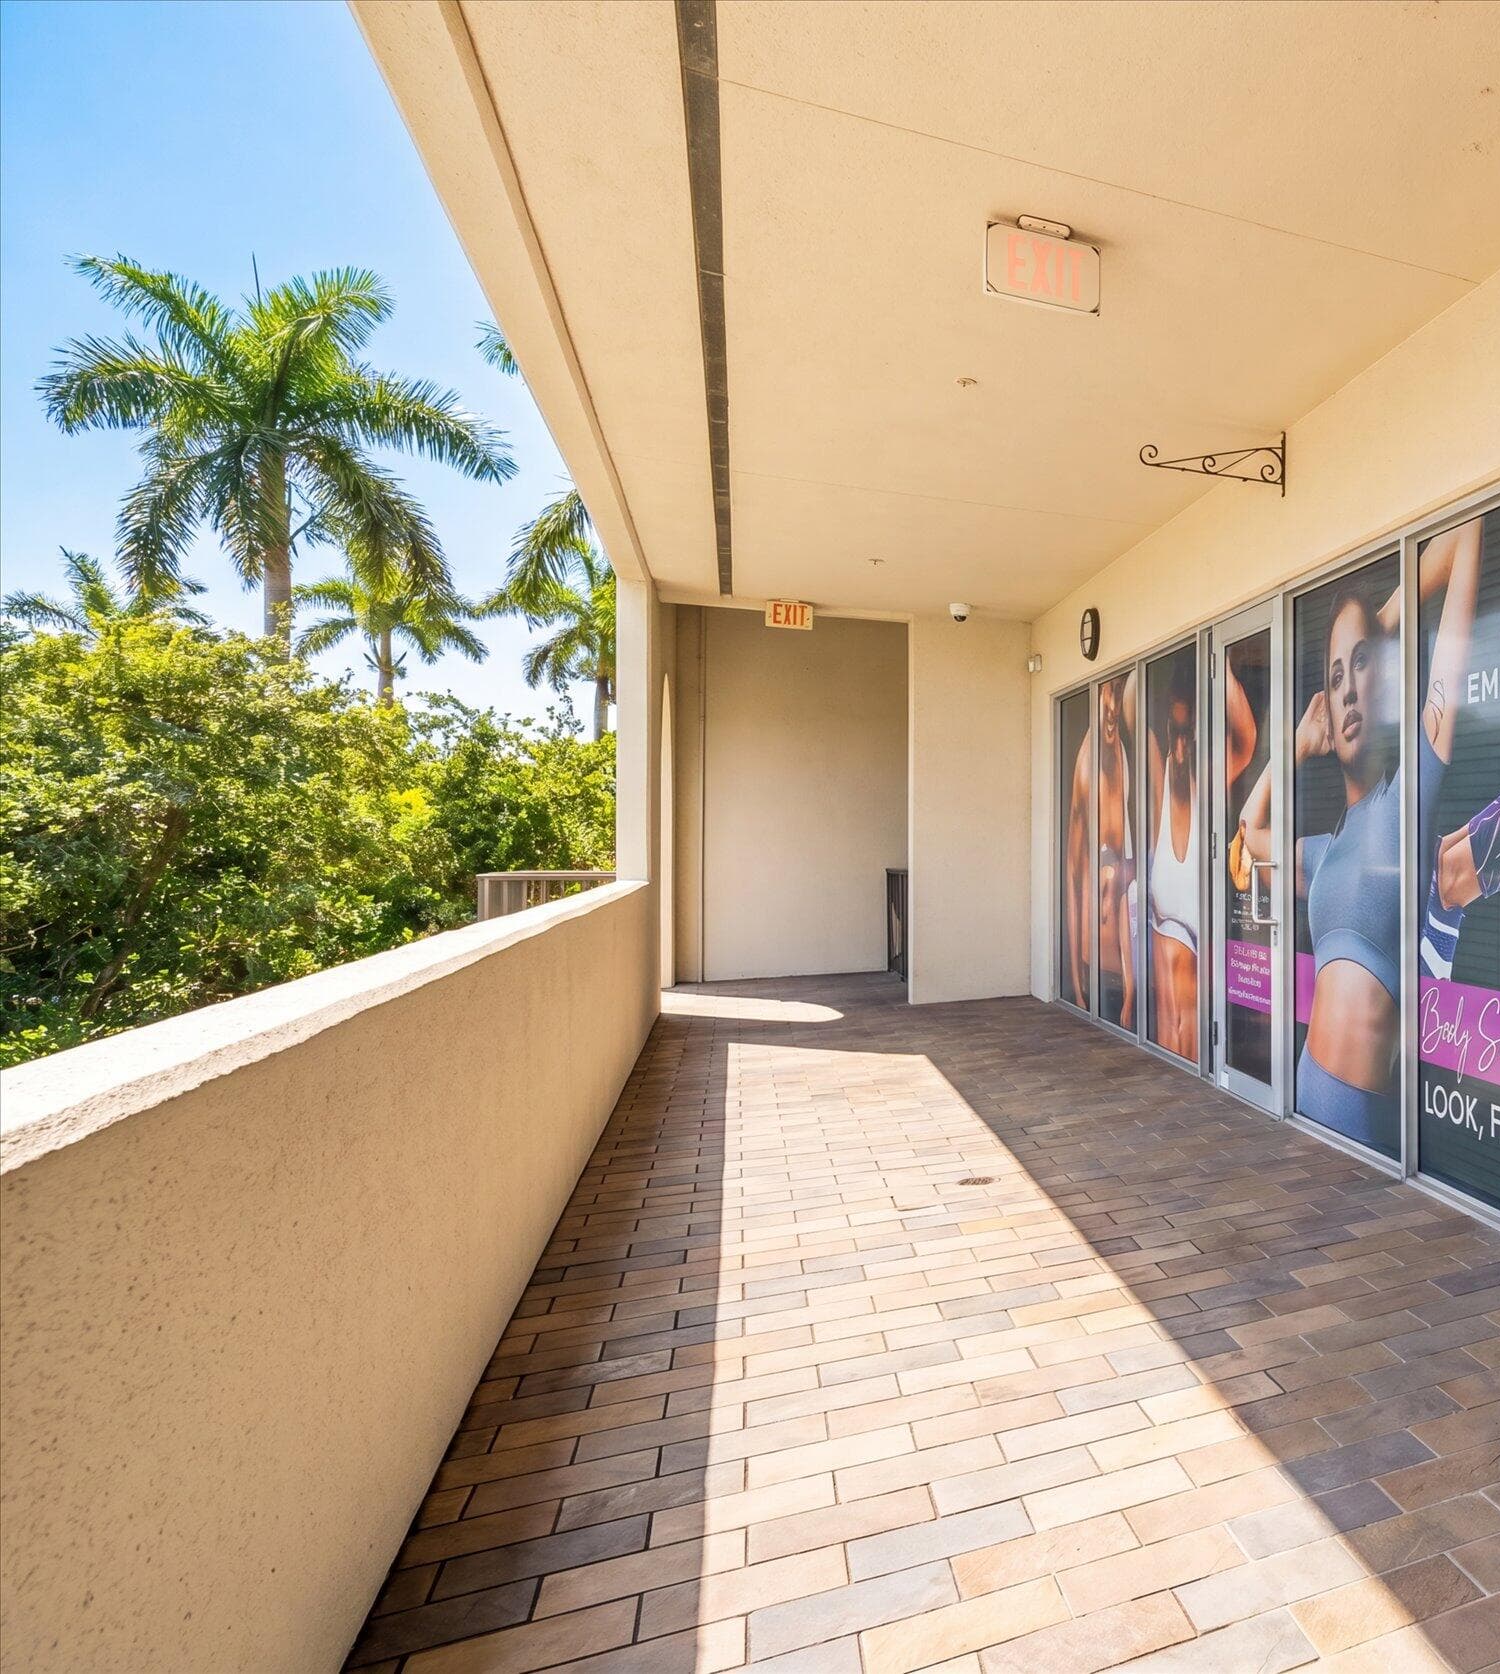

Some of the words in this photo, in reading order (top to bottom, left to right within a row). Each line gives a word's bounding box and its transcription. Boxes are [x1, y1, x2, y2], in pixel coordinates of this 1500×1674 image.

[1007, 232, 1088, 303] EXIT
[772, 603, 808, 626] EXIT
[1425, 1080, 1484, 1141] LOOK,
